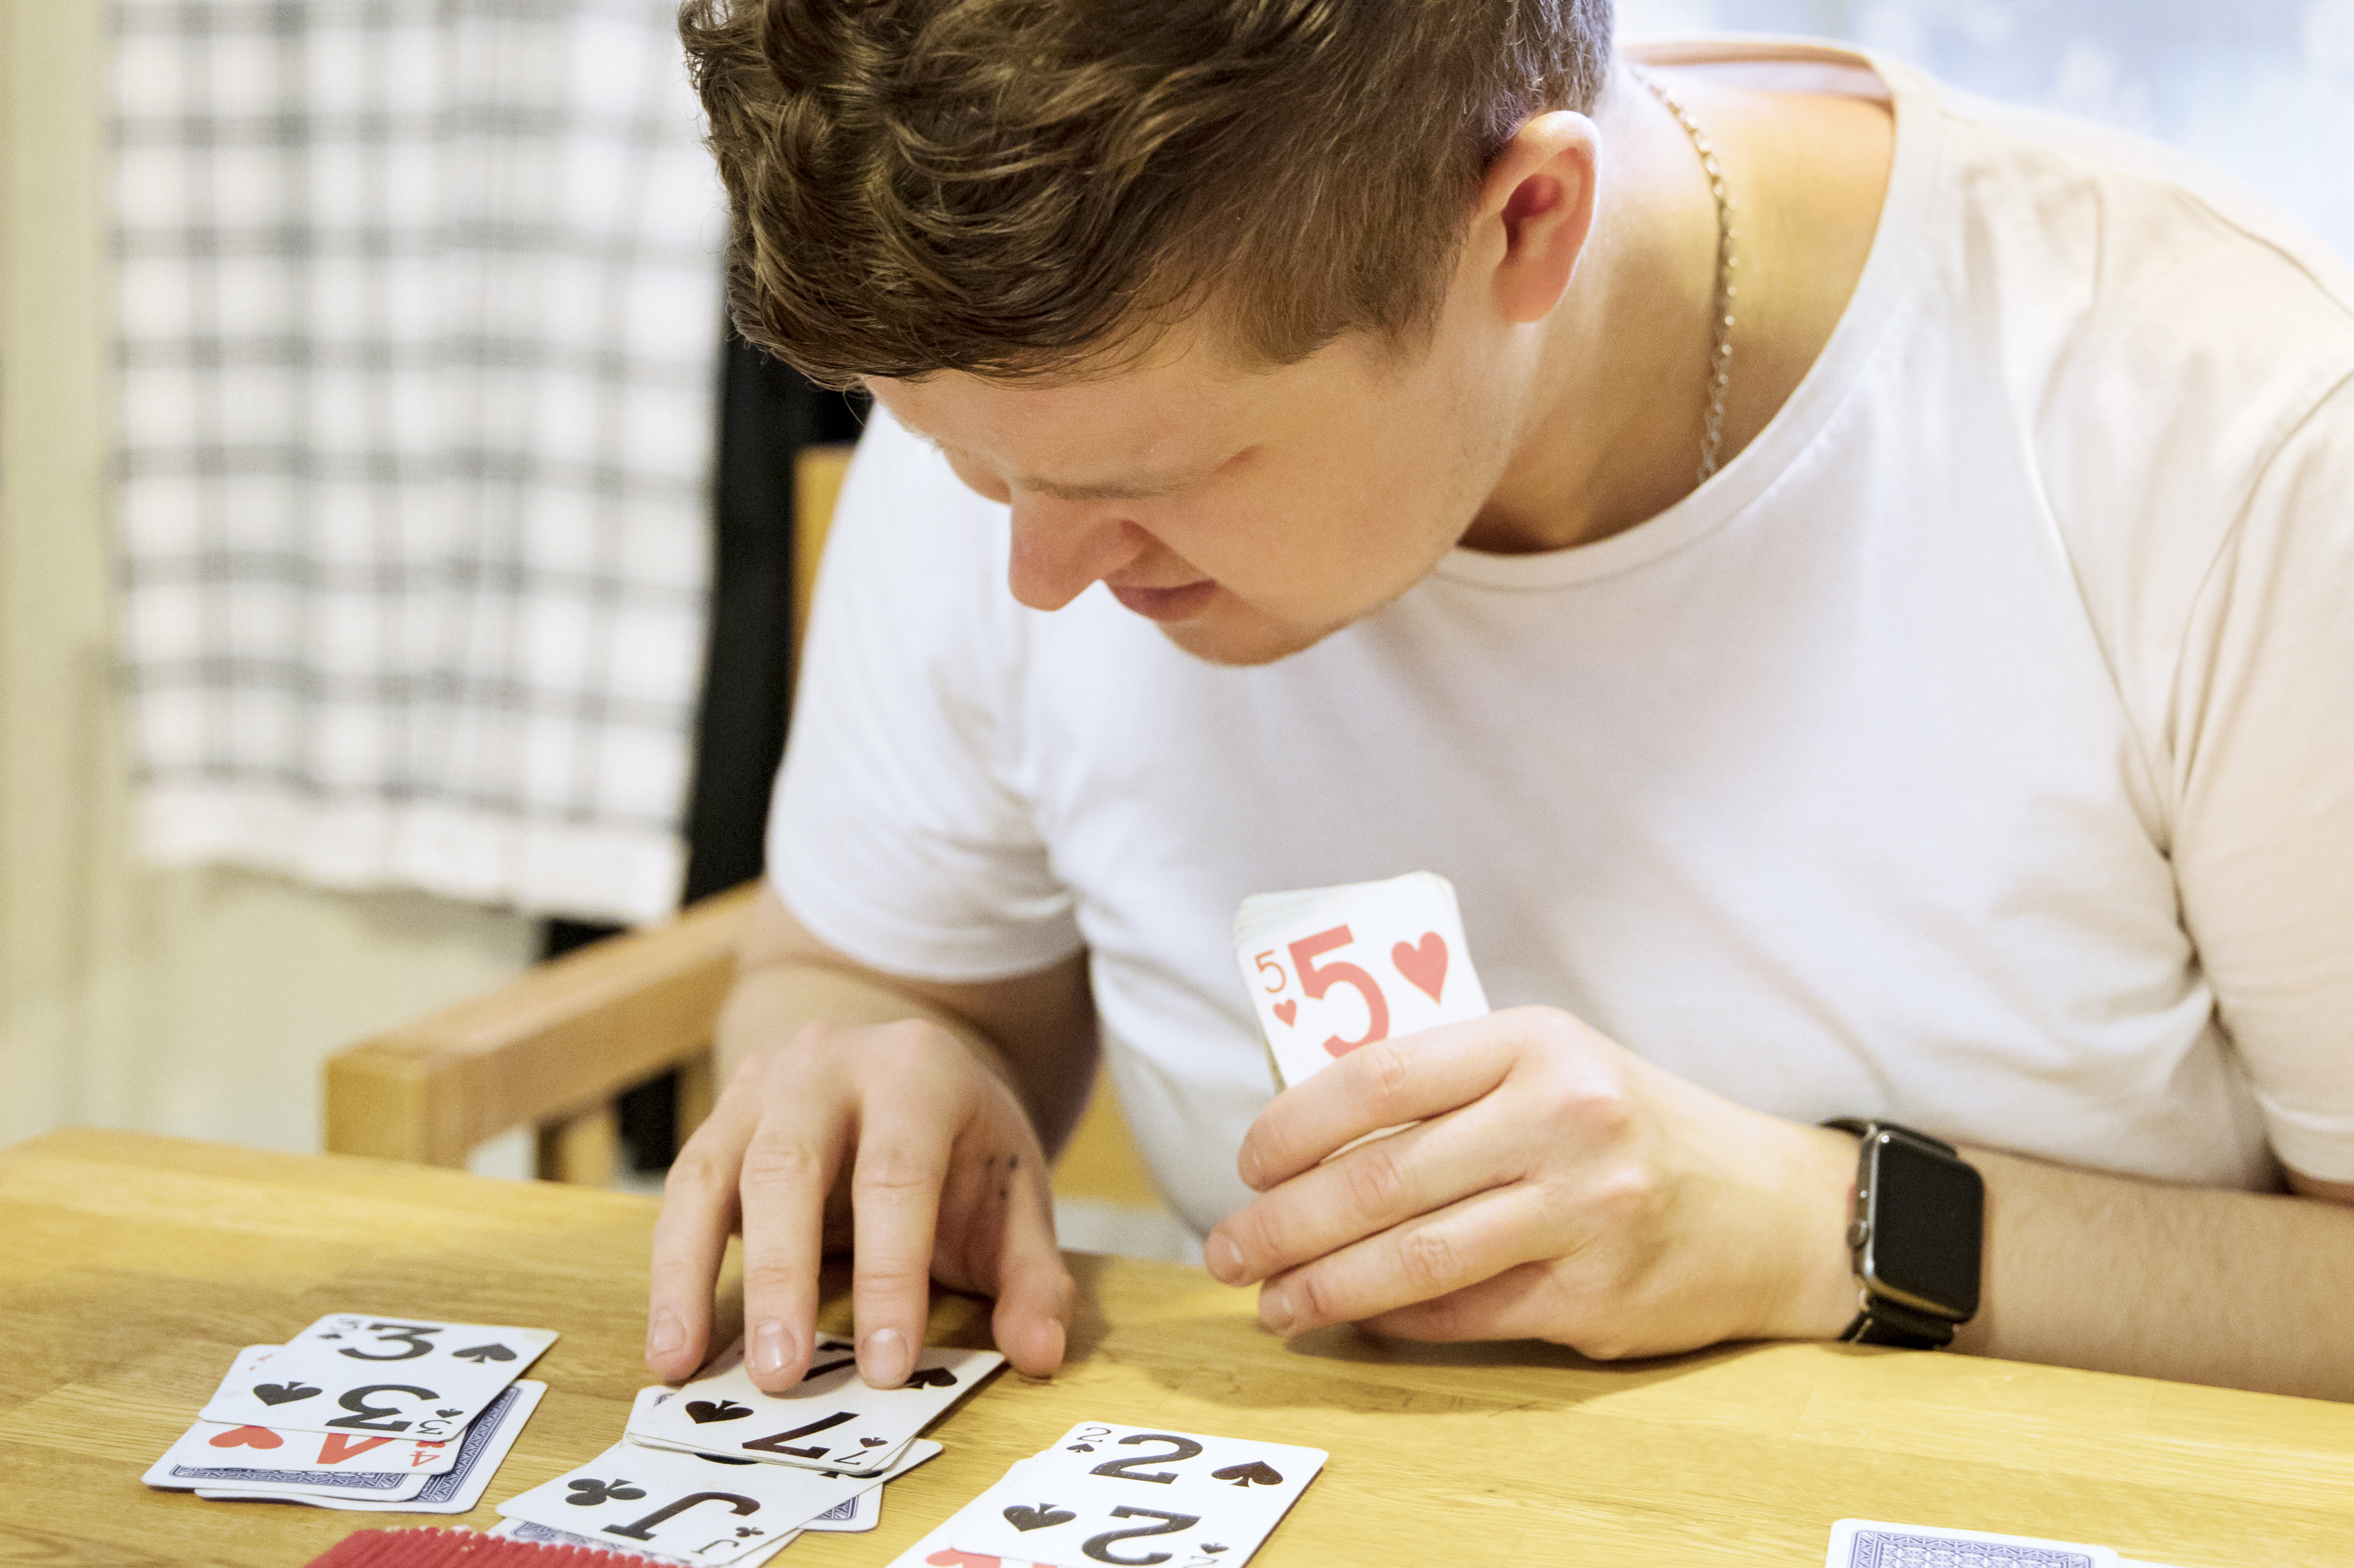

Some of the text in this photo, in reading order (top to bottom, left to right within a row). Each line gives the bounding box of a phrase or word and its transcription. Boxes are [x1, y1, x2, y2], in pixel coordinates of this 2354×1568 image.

[1254, 924, 1390, 1059] 5 5
[338, 1321, 444, 1361] 3
[324, 1384, 441, 1432] 3
[414, 1419, 452, 1435] 3
[409, 1450, 441, 1467] 4
[741, 1411, 861, 1460] 7
[833, 1450, 869, 1466] 7
[1076, 1427, 1204, 1485] 2 2
[600, 1491, 761, 1541] J
[1081, 1505, 1202, 1567] 2
[690, 1538, 740, 1555] J
